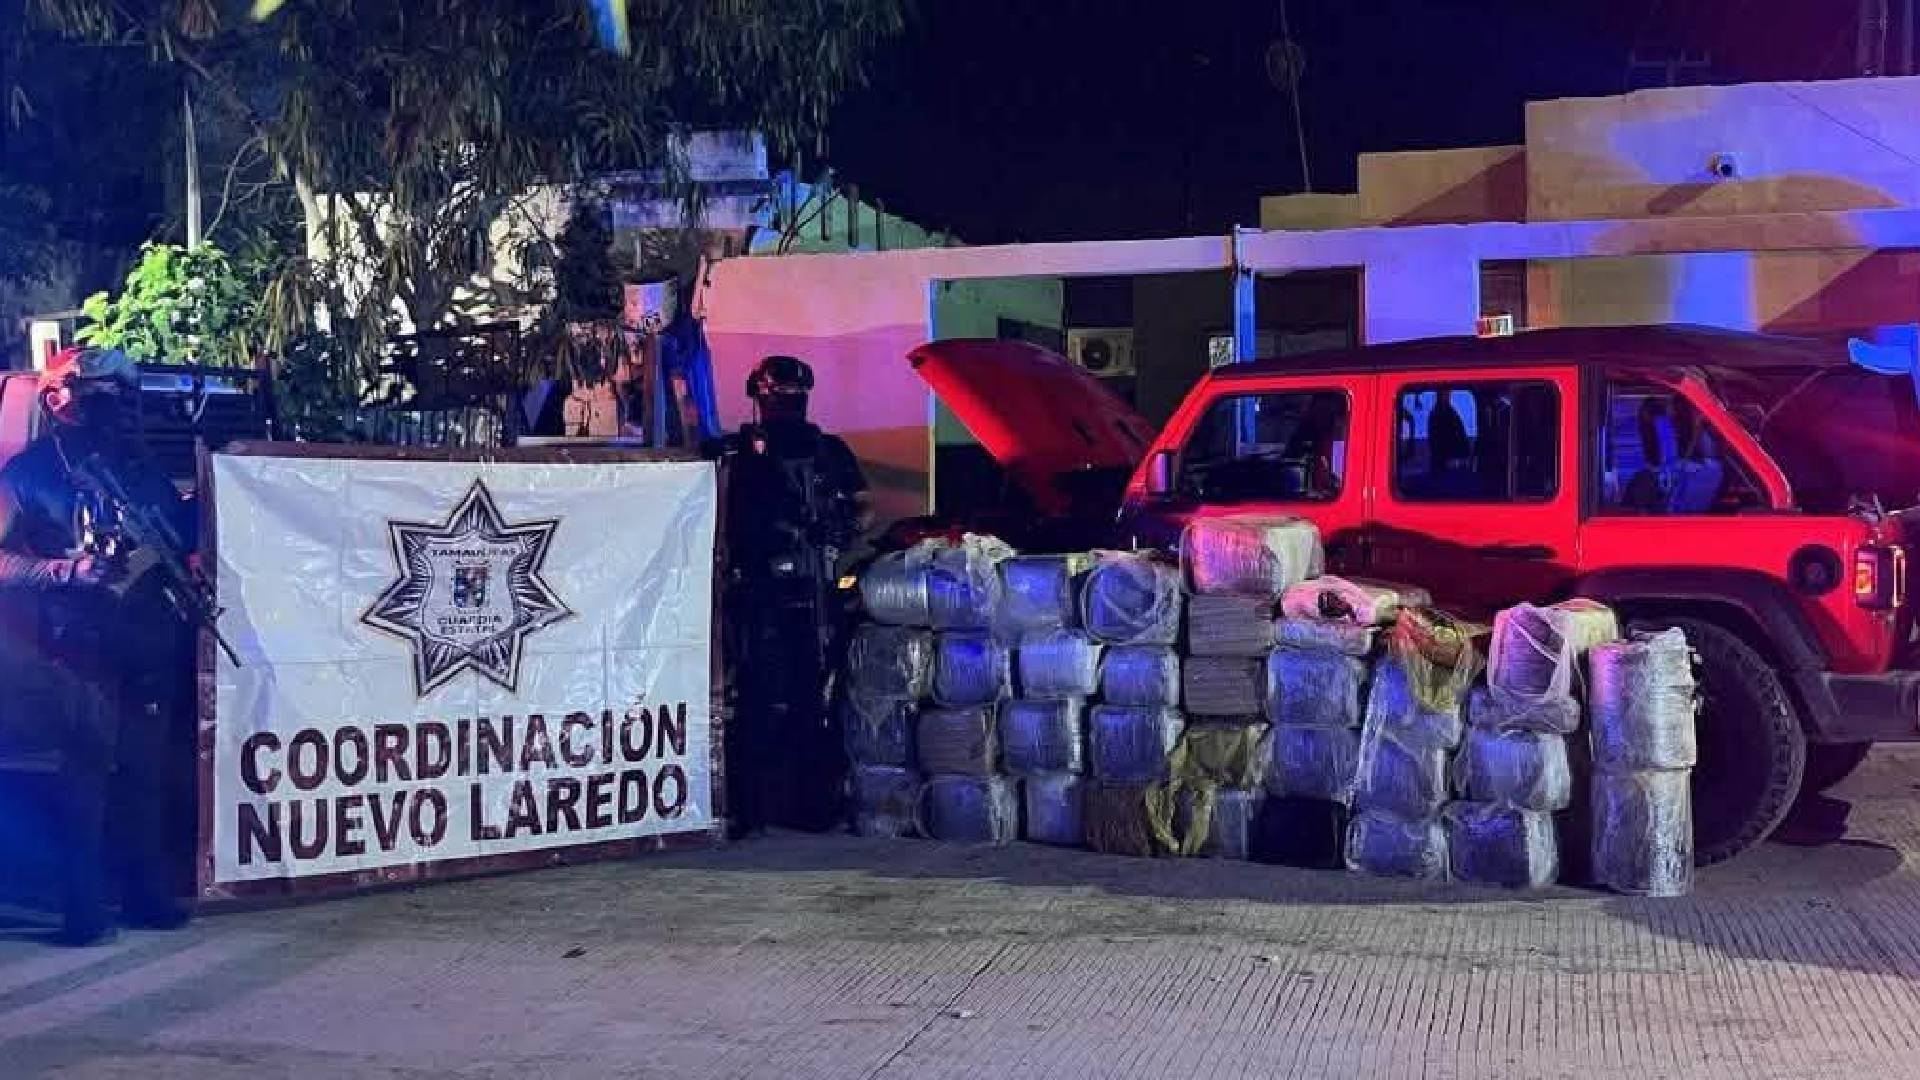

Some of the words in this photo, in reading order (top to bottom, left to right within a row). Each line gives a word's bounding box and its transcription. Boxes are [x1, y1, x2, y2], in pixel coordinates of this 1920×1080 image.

[240, 695, 687, 794] COORDINACIÓN
[238, 788, 448, 866] NUEVO
[470, 764, 687, 841] LAREDO
